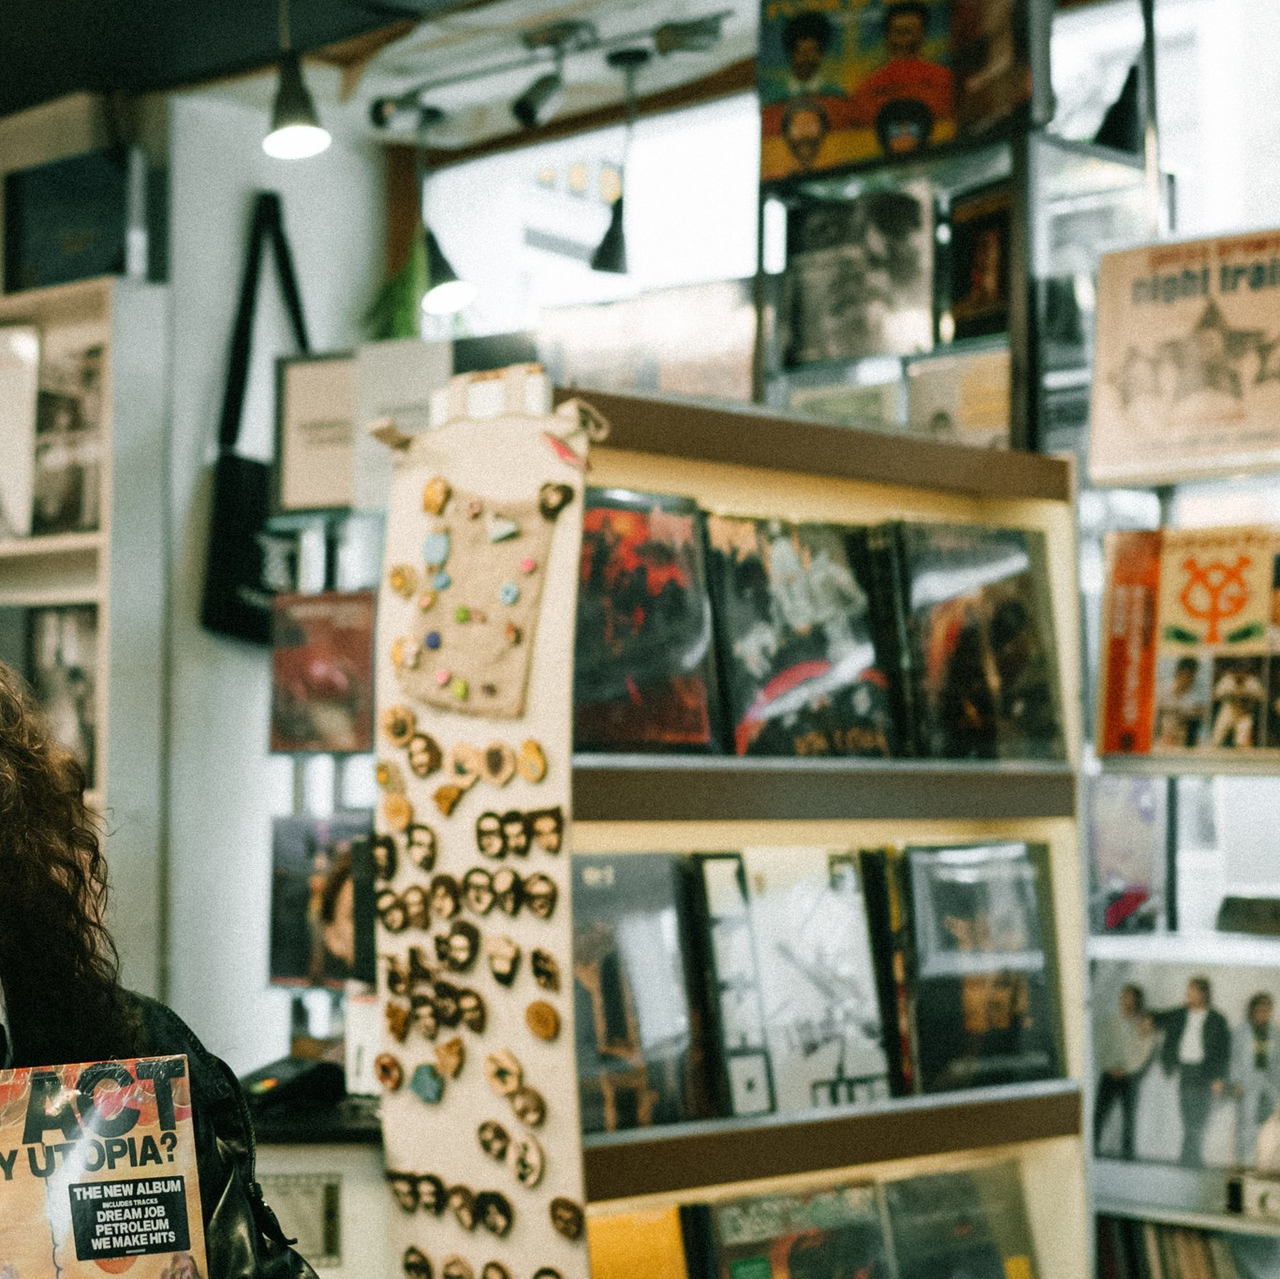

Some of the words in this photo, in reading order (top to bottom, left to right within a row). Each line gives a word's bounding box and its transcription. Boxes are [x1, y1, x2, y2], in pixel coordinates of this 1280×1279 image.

[22, 1058, 186, 1145] ACT
[27, 1131, 178, 1178] UTOPIA?
[73, 1186, 102, 1200] THE
[103, 1183, 133, 1198] NEW
[137, 1180, 181, 1195] ALBUM
[102, 1200, 133, 1209] INCLUDES
[133, 1198, 158, 1206] TRACKS
[96, 1209, 142, 1222] DREAM
[144, 1206, 166, 1218] JOB
[95, 1219, 170, 1236] PETROLEUM
[91, 1237, 111, 1250] WE
[112, 1233, 148, 1248] MAKE
[150, 1231, 176, 1244] HITS
